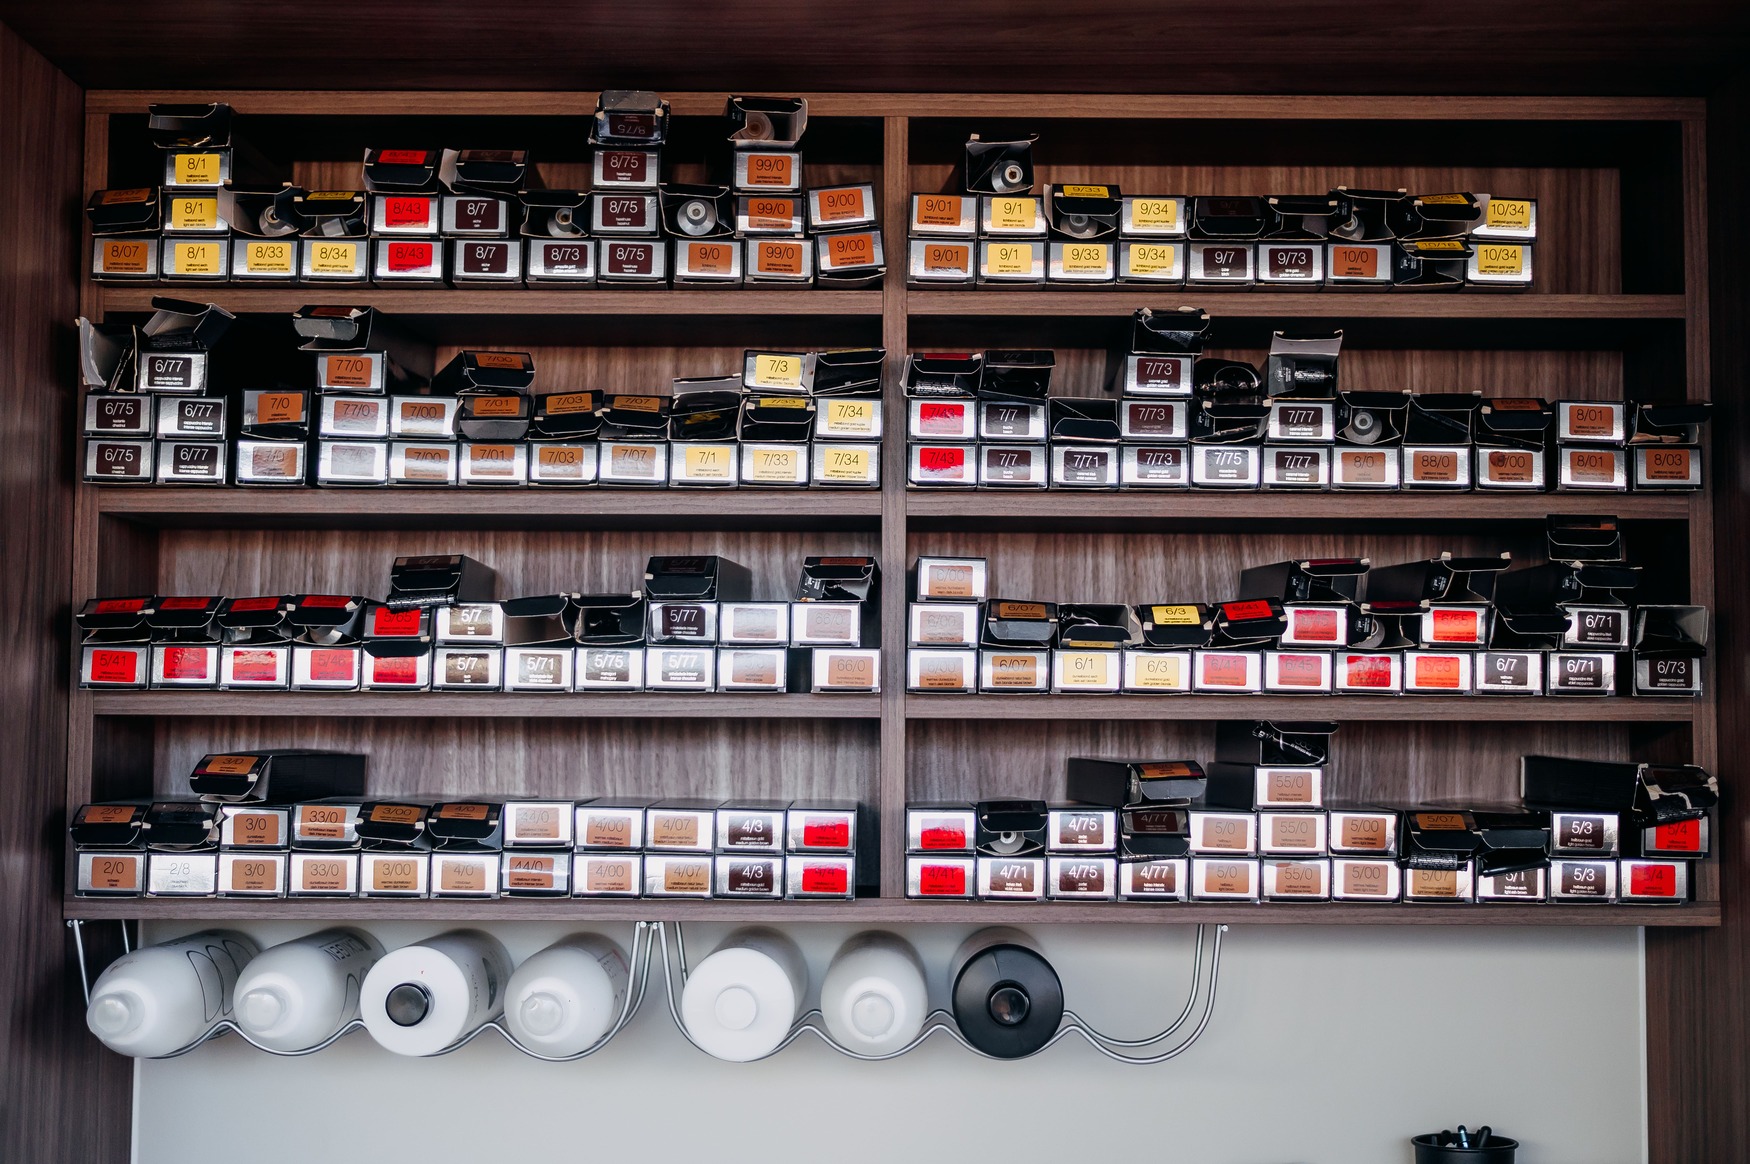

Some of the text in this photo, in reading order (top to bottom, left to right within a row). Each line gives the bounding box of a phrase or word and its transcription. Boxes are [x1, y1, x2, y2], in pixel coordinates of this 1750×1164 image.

[618, 124, 645, 134] 8/75
[187, 158, 206, 170] 8/1
[610, 156, 638, 168] 8/75
[756, 159, 784, 171] 99/0
[827, 194, 855, 207] 9/00
[925, 200, 952, 212] 9/01
[185, 202, 203, 214] 8/1
[393, 202, 421, 214] 8/43
[467, 203, 487, 215] 8/7
[609, 201, 638, 213] 8/75
[757, 203, 785, 215] 99/0
[1004, 203, 1022, 214] 9/1
[1140, 203, 1168, 215] 9/34
[1491, 204, 1524, 216] 10/34
[111, 246, 139, 258] 8/07
[256, 246, 283, 258] 8/33
[836, 240, 865, 252] 9/00
[187, 247, 206, 259] 8/1
[320, 247, 347, 259] 8/34
[396, 247, 424, 259] 8/43
[476, 247, 496, 259] 8/7
[551, 248, 579, 260] 8/73
[616, 248, 644, 260] 8/75
[700, 247, 720, 259] 9/0
[766, 247, 794, 259] 99/0
[933, 249, 959, 261] 9/01
[1000, 248, 1018, 260] 9/1
[1072, 249, 1100, 260] 9/33
[1138, 248, 1165, 260] 9/34
[1215, 252, 1234, 264] 9/7
[1278, 252, 1306, 265] 9/73
[1342, 251, 1368, 263] 10/0
[1484, 249, 1517, 261] 10/34
[155, 360, 183, 372] 6/77
[336, 359, 363, 372] 77/0
[770, 360, 788, 372] 7/3
[1146, 363, 1172, 375] 7/73
[271, 398, 289, 409] 7/0
[484, 399, 509, 407] 7/01
[556, 397, 582, 405] 7/03
[105, 403, 133, 415] 6/75
[185, 404, 213, 417] 6/77
[343, 404, 370, 416] 77/0
[411, 406, 437, 418] 7/00
[838, 405, 863, 417] 7/34
[930, 408, 954, 418] 7/43
[1138, 408, 1165, 420] 7/73
[1577, 409, 1603, 421] 8/01
[999, 409, 1017, 422] 7/7
[1288, 411, 1314, 423] 7/77
[105, 449, 133, 461] 6/75
[180, 448, 208, 461] 6/77
[414, 452, 441, 461] 7/00
[480, 450, 505, 461] 7/01
[548, 451, 574, 463] 7/03
[622, 449, 647, 461] 7/07
[699, 452, 716, 463] 7/1
[763, 454, 788, 465] 7/33
[834, 453, 859, 465] 7/34
[930, 453, 954, 464] 7/43
[1000, 454, 1017, 466] 7/7
[1146, 453, 1173, 465] 7/73
[1215, 452, 1242, 465] 7/75
[1654, 454, 1682, 466] 8/03
[1074, 455, 1098, 469] 7/71
[1285, 456, 1311, 469] 7/77
[1354, 456, 1374, 468] 8/0
[1422, 456, 1449, 468] 88/0
[1497, 456, 1525, 468] 8/00
[1577, 456, 1603, 467] 8/01
[937, 569, 964, 581] 6/00
[384, 612, 412, 623] 5/65
[461, 609, 481, 623] 5/7
[670, 610, 697, 622] 5/77
[815, 613, 843, 625] 66/0
[928, 615, 955, 627] 6/00
[1441, 614, 1468, 626] 6/55
[1586, 615, 1612, 628] 6/71
[100, 655, 126, 666] 5/41
[457, 658, 477, 671] 5/7
[526, 657, 554, 671] 5/71
[594, 655, 623, 668] 5/75
[669, 655, 697, 668] 5/77
[837, 660, 865, 672] 66/0
[1000, 660, 1027, 672] 6/07
[1075, 658, 1093, 670] 6/1
[1211, 658, 1238, 671] 6/41
[1286, 659, 1313, 671] 6/45
[1424, 660, 1450, 672] 6/55
[1496, 659, 1516, 671] 6/7
[1567, 660, 1594, 672] 6/71
[1148, 661, 1167, 674] 6/3
[1657, 661, 1686, 674] 6/73
[1276, 776, 1304, 788] 55/0
[310, 810, 338, 824] 33/0
[1141, 814, 1168, 822] 4/77
[246, 818, 266, 830] 3/0
[596, 819, 624, 832] 4/00
[663, 819, 690, 831] 4/07
[742, 820, 763, 832] 4/3
[1069, 818, 1097, 831] 4/75
[1215, 822, 1235, 835] 5/0
[1280, 822, 1308, 834] 55/0
[1351, 820, 1379, 832] 5/00
[1572, 822, 1592, 834] 5/3
[1667, 824, 1687, 835] 5/4
[104, 862, 124, 874] 2/0
[170, 863, 190, 875] 2/8
[245, 864, 265, 876] 3/0
[311, 864, 339, 876] 33/0
[383, 863, 411, 876] 3/00
[454, 865, 474, 876] 4/0
[515, 861, 543, 874] 44/0
[596, 865, 624, 878] 4/00
[674, 865, 701, 878] 4/07
[743, 866, 763, 878] 4/3
[928, 867, 955, 879] 4/41
[1000, 866, 1026, 878] 4/71
[1069, 866, 1097, 878] 4/75
[1140, 866, 1169, 879] 4/77
[1217, 866, 1237, 879] 5/0
[1352, 867, 1380, 879] 5/00
[1285, 868, 1312, 880] 55/0
[1422, 871, 1448, 881] 5/07
[1574, 868, 1594, 881] 5/3
